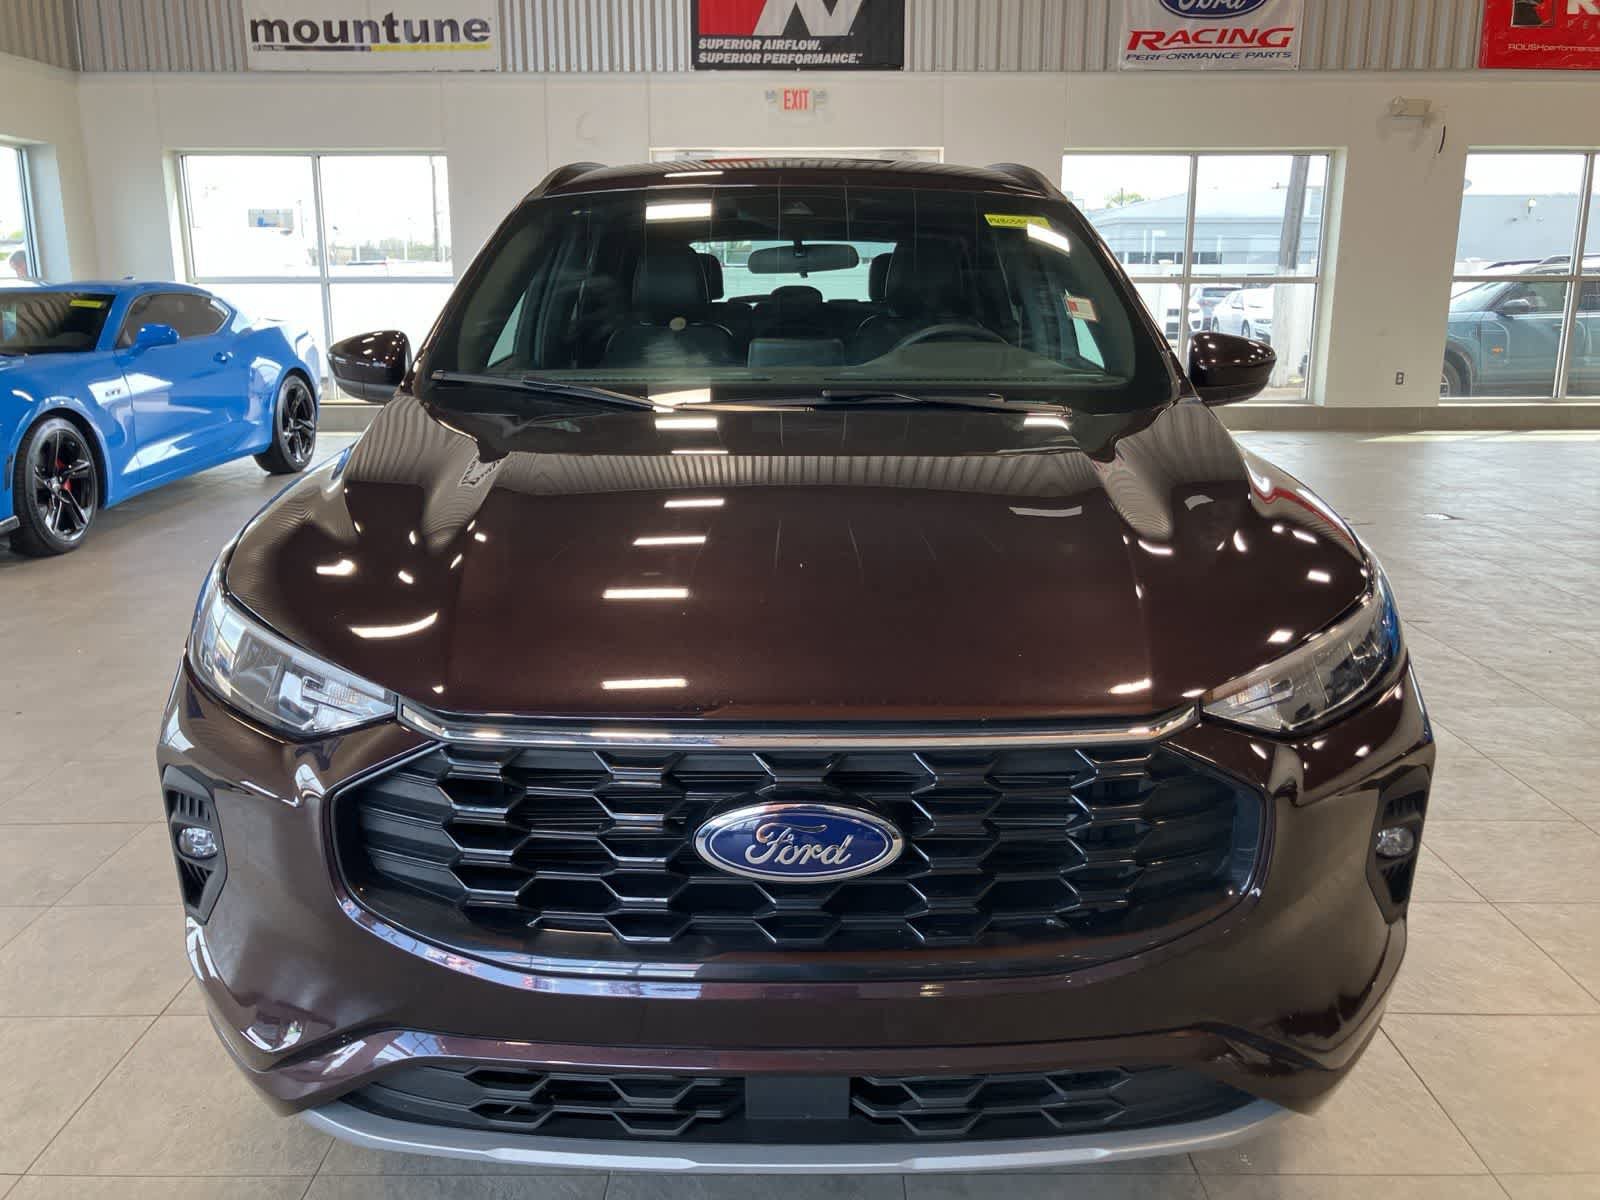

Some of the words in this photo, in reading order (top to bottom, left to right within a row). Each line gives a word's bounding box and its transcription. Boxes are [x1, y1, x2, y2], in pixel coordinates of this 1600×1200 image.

[250, 12, 490, 44] mountune
[1126, 27, 1294, 51] RACING
[698, 38, 762, 50] SUPERIOR
[764, 39, 821, 51] AIRFLOW.
[1126, 52, 1241, 61] PERFORMANCE
[1244, 51, 1293, 59] PARTS
[698, 52, 762, 64] SUPERIOR
[783, 88, 810, 111] EXIT
[745, 822, 854, 865] Ford
